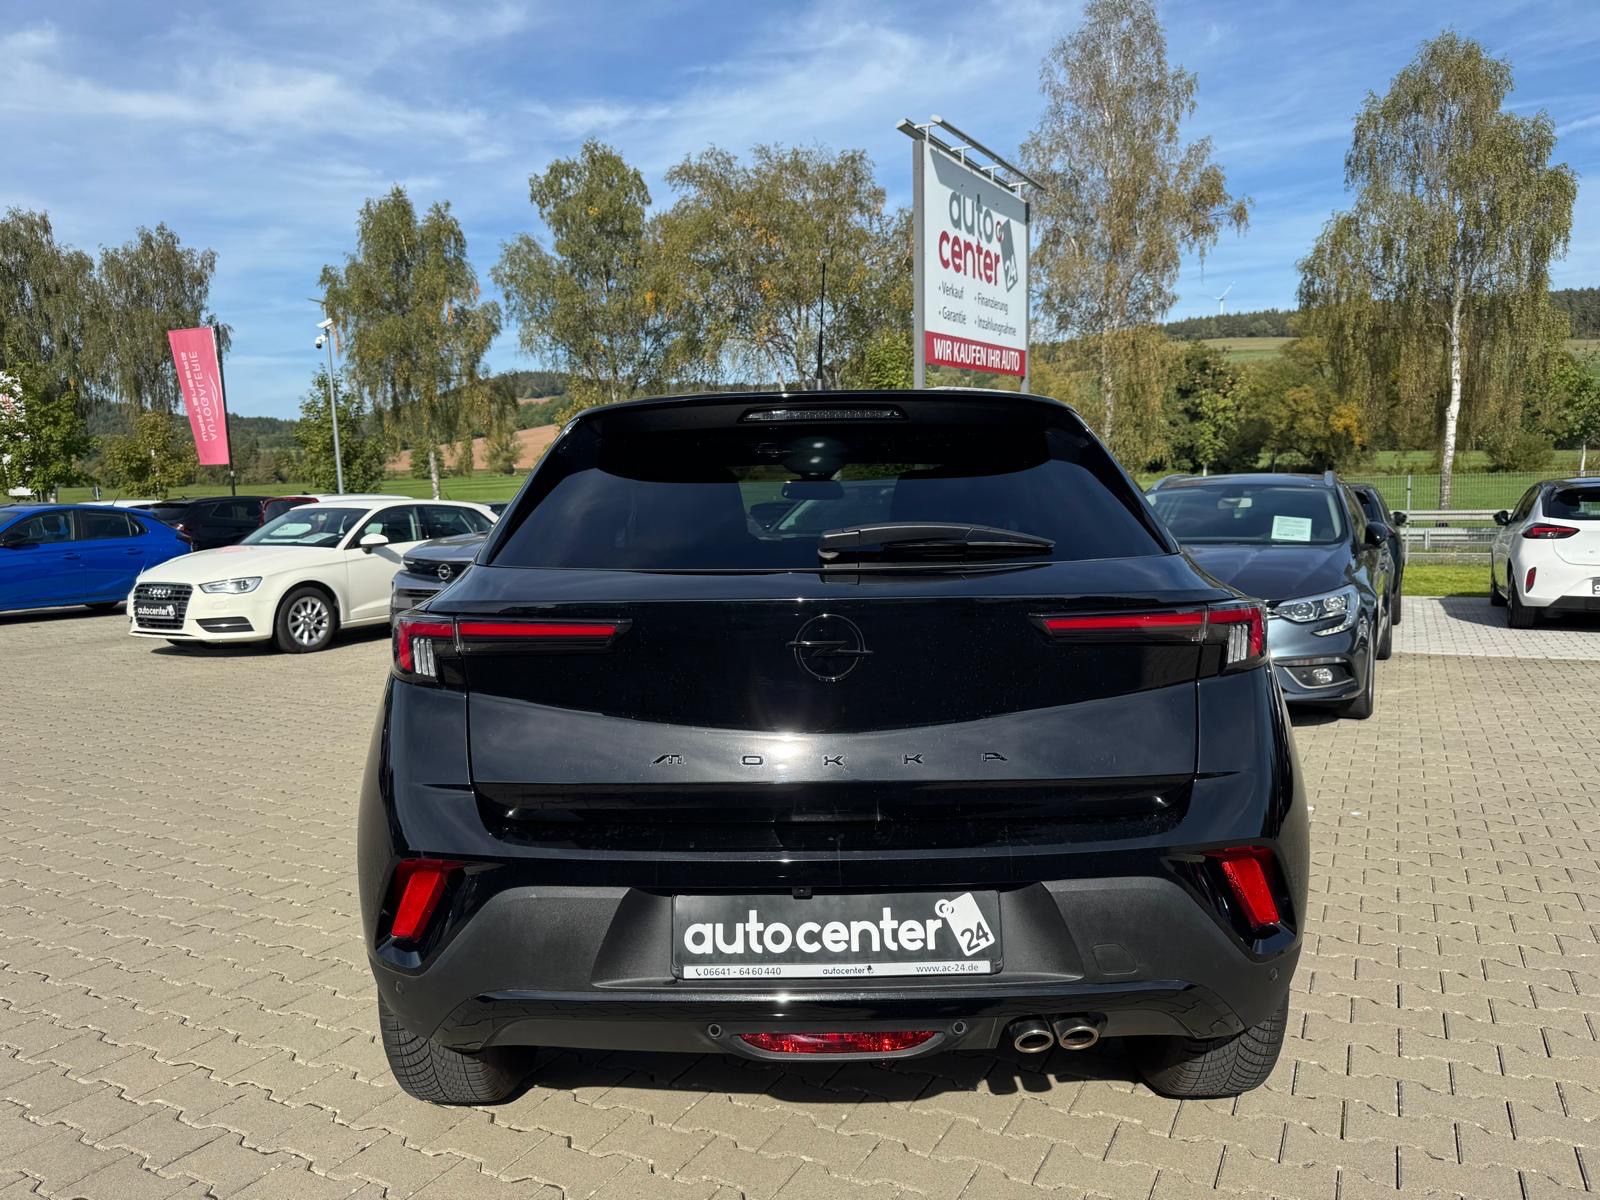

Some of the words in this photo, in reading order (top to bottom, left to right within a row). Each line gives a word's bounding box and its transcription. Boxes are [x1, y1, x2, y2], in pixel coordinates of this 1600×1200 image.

[949, 191, 994, 244] auto
[938, 230, 1001, 286] center
[1005, 255, 1017, 285] 24
[942, 280, 964, 300] Verkauf
[977, 292, 1008, 315] Finanzierung
[942, 306, 966, 325] Garantie
[977, 315, 1017, 337] Inzahlungnahme
[933, 338, 952, 362] WIR
[953, 341, 987, 367] KAUFEN
[987, 348, 1001, 369] IHR
[1001, 350, 1020, 371] AUTO
[138, 604, 168, 616] autocenter
[684, 907, 943, 955] autocenter
[960, 921, 990, 952] 24
[703, 967, 731, 976] 06641
[822, 966, 865, 975] autocenter
[915, 963, 979, 973] www.ac-24.de
